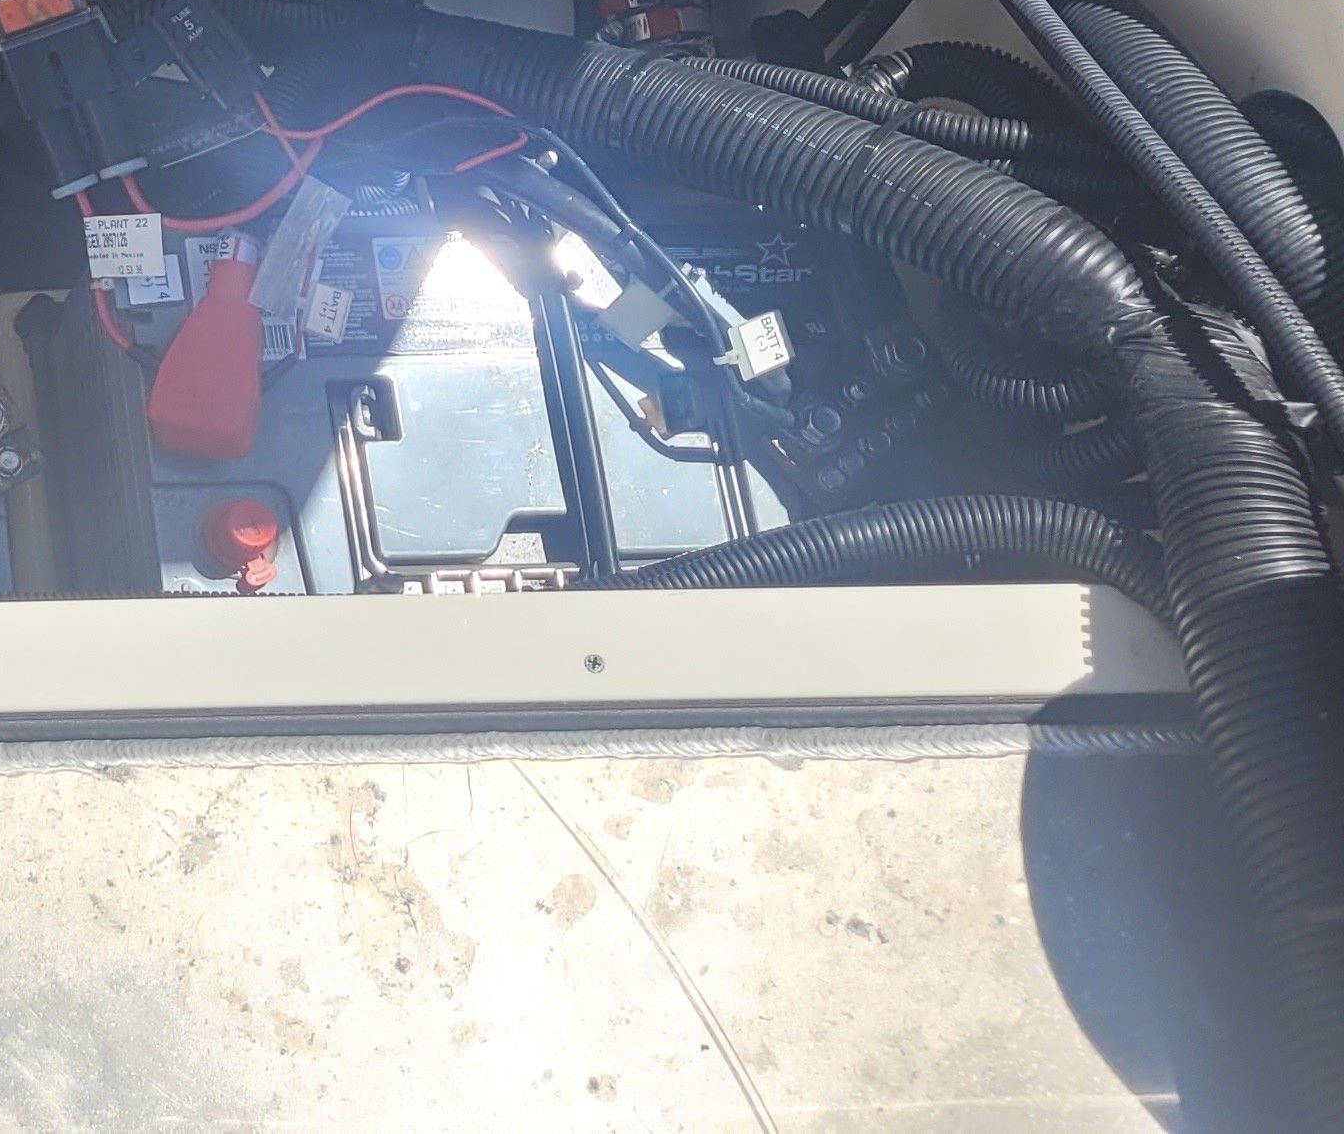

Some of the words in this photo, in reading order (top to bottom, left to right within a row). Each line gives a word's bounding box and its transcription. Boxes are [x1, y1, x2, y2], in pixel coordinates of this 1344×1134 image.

[184, 19, 195, 31] 5
[97, 219, 128, 230] PLANT
[135, 218, 148, 228] 22
[327, 290, 341, 323] BATT
[761, 316, 780, 349] BATT
[775, 352, 784, 361] 4
